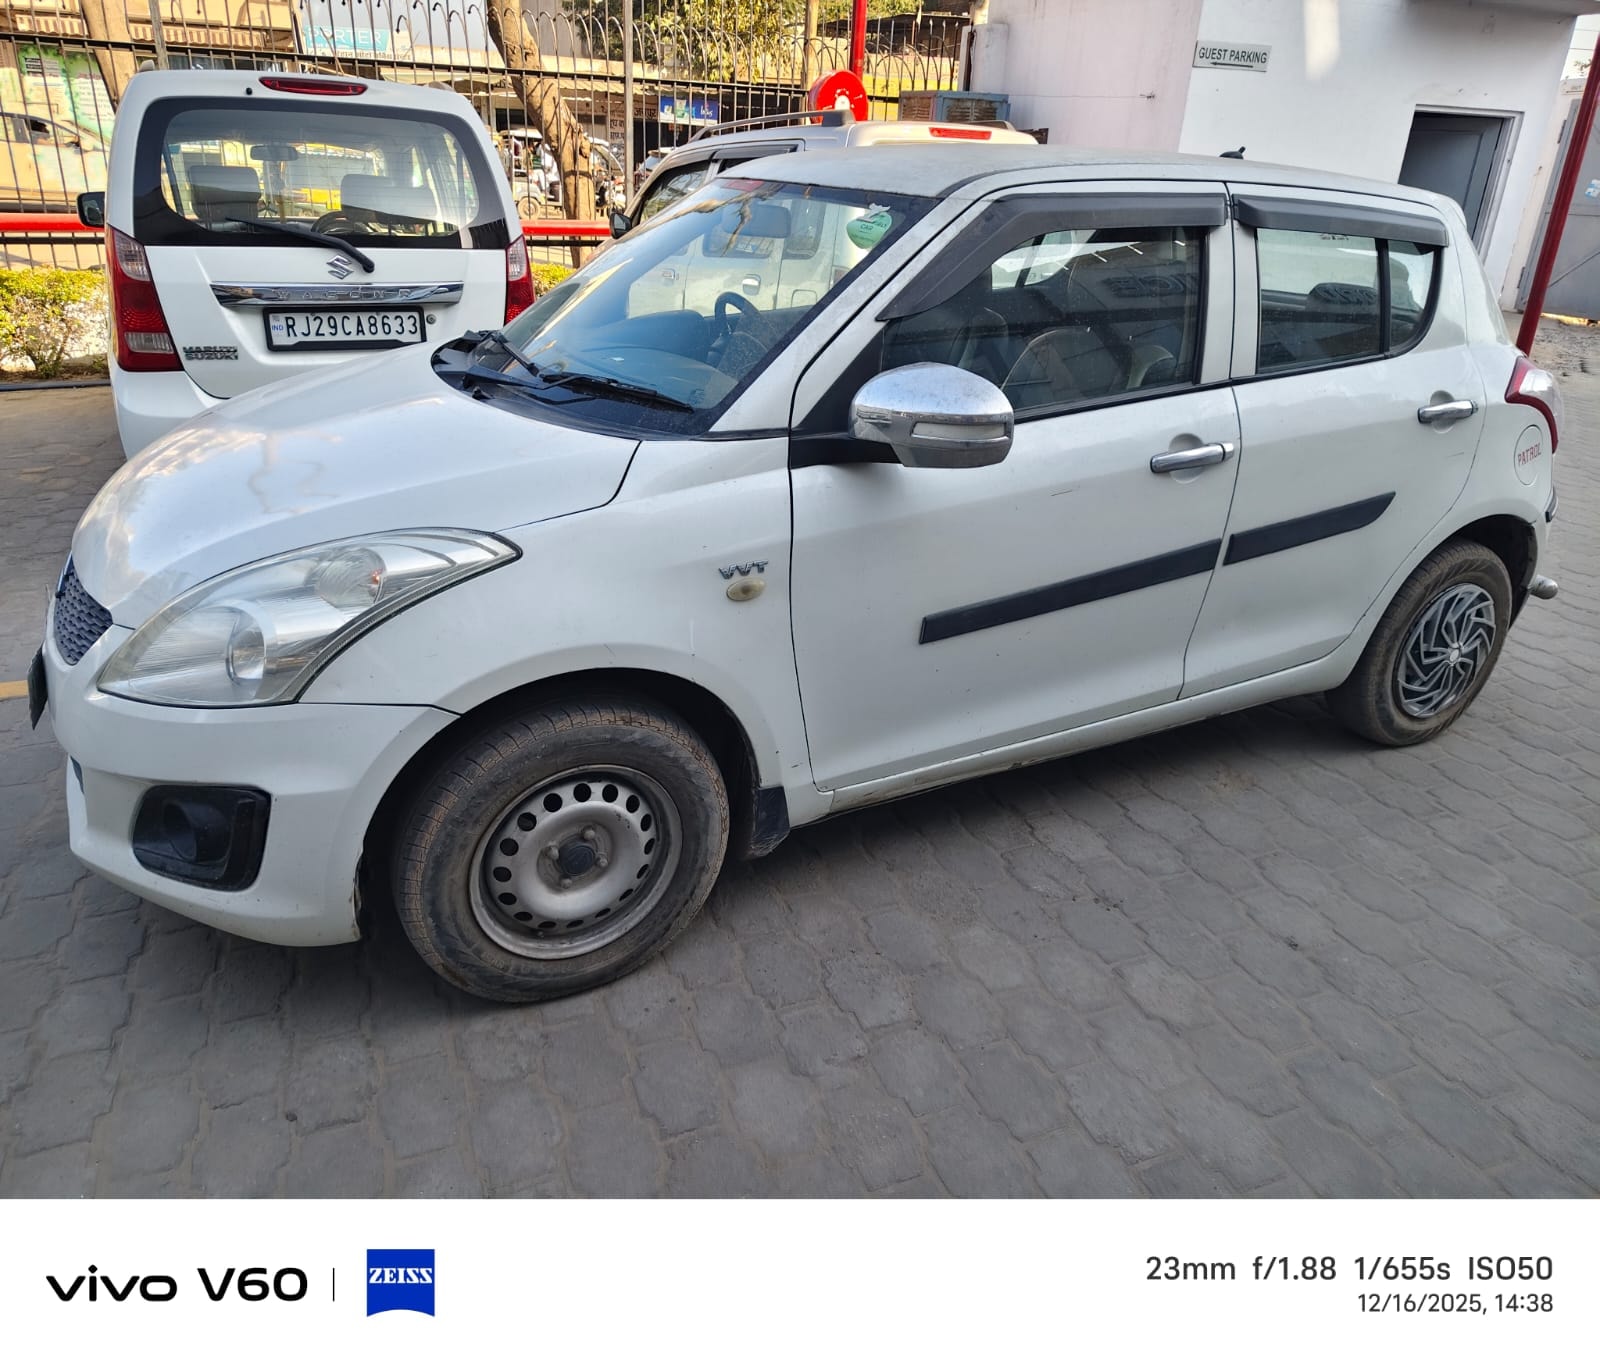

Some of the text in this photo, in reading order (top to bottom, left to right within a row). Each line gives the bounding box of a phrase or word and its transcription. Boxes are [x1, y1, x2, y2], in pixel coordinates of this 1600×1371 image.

[308, 27, 382, 45] PORTER
[1199, 47, 1267, 64] GUEST PARKING
[285, 313, 418, 338] RJ29CA8633
[184, 352, 239, 360] SUZUKI
[718, 560, 769, 580] VVT
